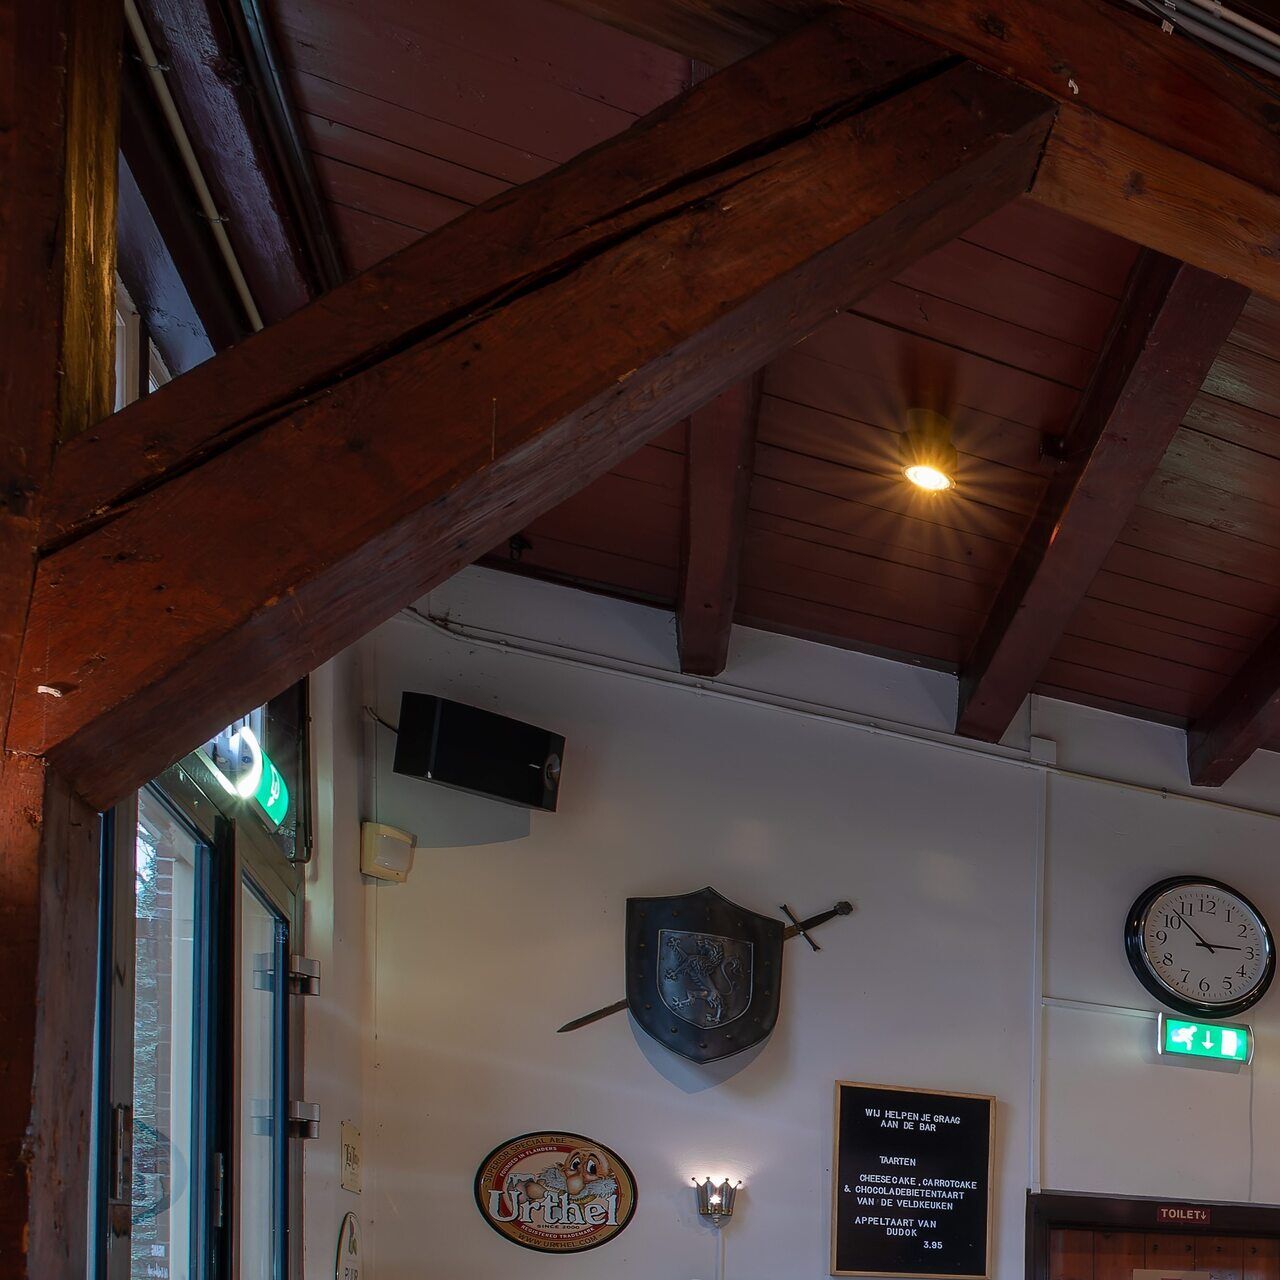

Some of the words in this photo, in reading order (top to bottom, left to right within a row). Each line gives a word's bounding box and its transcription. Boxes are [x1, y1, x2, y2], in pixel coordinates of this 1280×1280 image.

[1180, 901, 1193, 917] 11
[1199, 899, 1216, 915] 12
[1164, 914, 1181, 930] 10
[1225, 909, 1232, 923] 1
[1155, 930, 1168, 946] 9
[1237, 924, 1248, 939] 2
[1162, 952, 1174, 967] 8
[1244, 946, 1255, 960] 3
[1180, 969, 1191, 983] 7
[1235, 964, 1247, 978] 4
[1198, 977, 1210, 992] 6
[1222, 976, 1233, 990] 5
[865, 1108, 880, 1118] WIJ
[885, 1110, 919, 1121] HELPEN
[921, 1113, 931, 1122] JE
[933, 1115, 961, 1125] GRAAG
[880, 1120, 899, 1129] AAN
[903, 1121, 914, 1130] DE
[919, 1123, 936, 1132] BAR
[483, 1149, 512, 1184] SUPERIOR
[511, 1136, 547, 1153] SPECIAL
[550, 1136, 567, 1145] ALE
[879, 1155, 917, 1167] TAARTEN
[844, 1184, 852, 1193] &
[855, 1185, 965, 1200] CHOCOLADEBIETENTAART
[488, 1187, 621, 1227] Urthel
[857, 1196, 875, 1206] VAN
[881, 1198, 893, 1207] DE
[896, 1199, 954, 1211] VELDKEUKEN
[1161, 1208, 1201, 1220] TOILET
[854, 1216, 915, 1228] APPELTAART
[917, 1219, 937, 1229] VAN
[520, 1224, 559, 1239] REGISTERED
[559, 1226, 595, 1239] TRADEMARK
[886, 1227, 918, 1237] DUDOK
[518, 1231, 599, 1249] WWW.URTHEL.COM
[923, 1240, 943, 1250] 3.95
